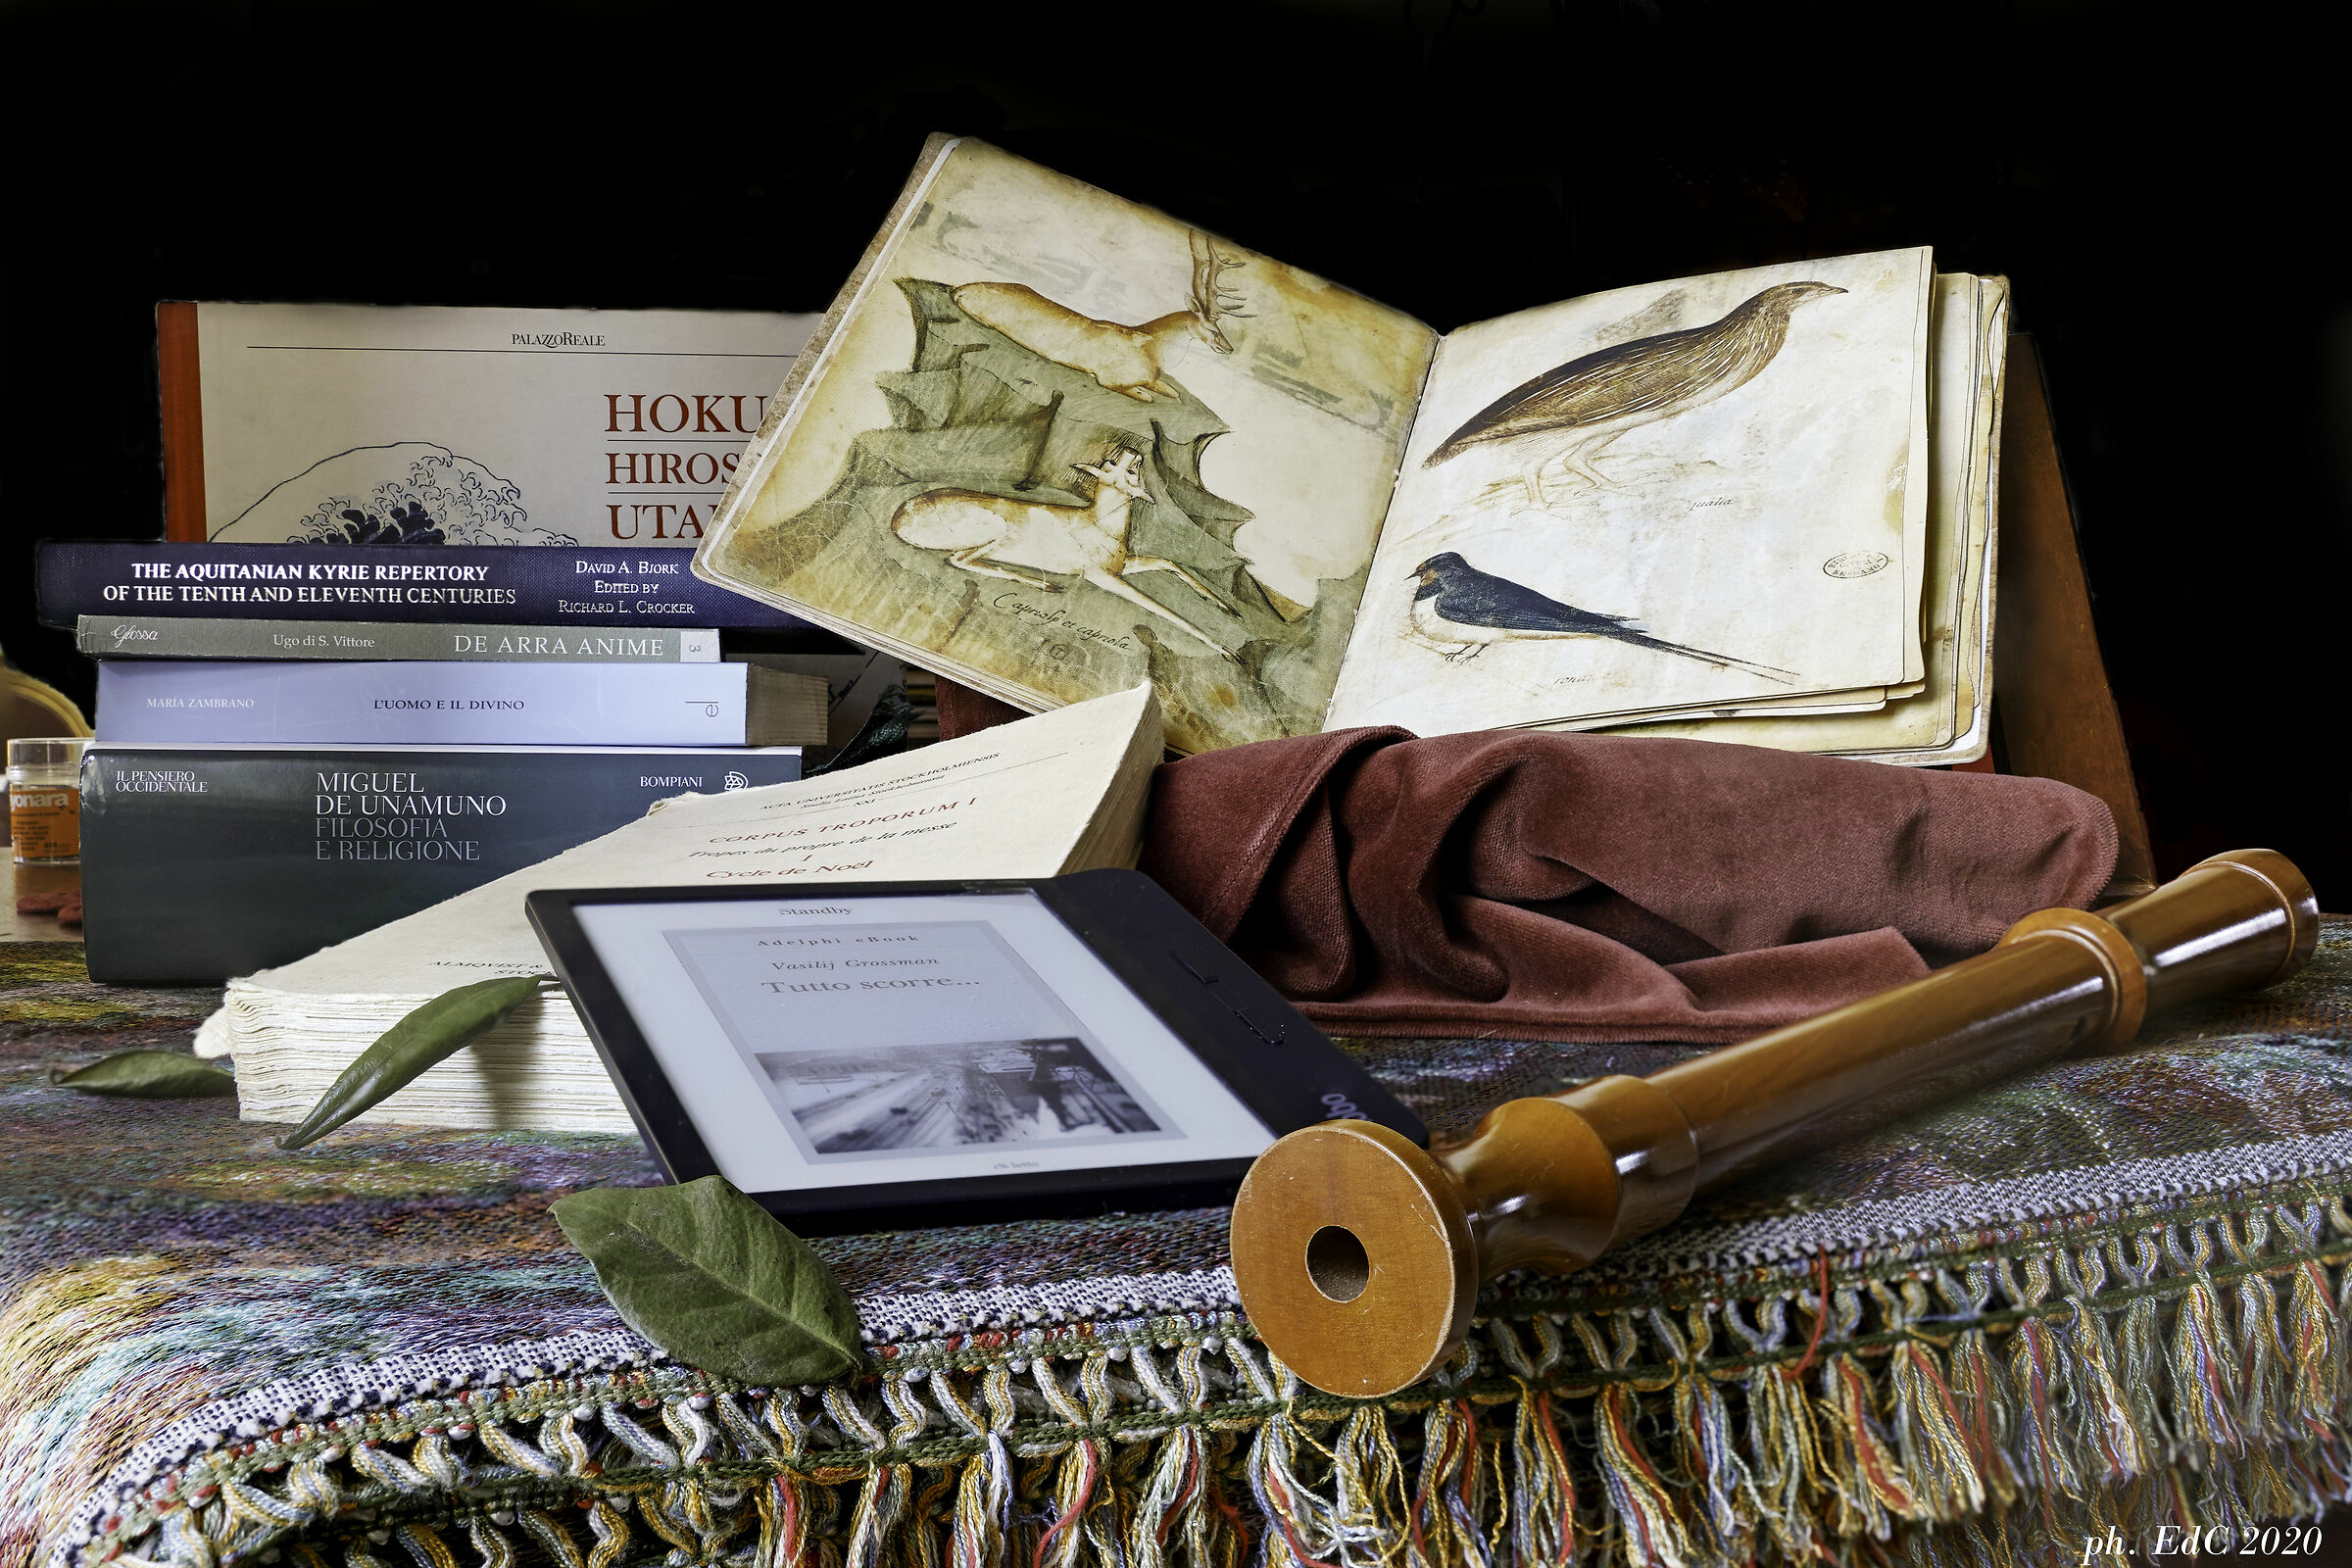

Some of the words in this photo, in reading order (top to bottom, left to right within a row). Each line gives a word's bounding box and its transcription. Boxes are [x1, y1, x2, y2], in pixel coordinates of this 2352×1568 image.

[606, 504, 717, 540] UTA
[131, 563, 172, 579] THE
[174, 564, 302, 581] AQUITANIAN
[309, 564, 369, 580] KYRIE
[375, 564, 489, 581] REPERTORY
[575, 560, 614, 574] DAVID
[617, 560, 633, 574] A.
[594, 579, 638, 594] EDITED
[642, 583, 660, 594] BY
[103, 585, 130, 602] OF
[133, 585, 173, 602] THE
[179, 586, 246, 602] TENTH
[249, 586, 293, 603] AND
[297, 587, 402, 604] ELEVENTH
[407, 588, 516, 605] CENTURIES
[558, 599, 614, 613] RICHARD
[617, 600, 632, 613] L.
[636, 600, 695, 614] CROCKER
[111, 624, 159, 648] Glossa
[273, 634, 300, 649] Ugo
[303, 634, 316, 647] di
[318, 635, 329, 647] S.
[334, 635, 375, 648] Vittore
[454, 635, 487, 653] DE
[497, 636, 568, 655] ARRA
[577, 637, 663, 656] ANIME
[147, 696, 184, 709] MARÍA
[188, 698, 255, 709] ZAMBRANO
[373, 699, 432, 710] L'UOMO
[436, 700, 446, 710] E
[450, 700, 465, 710] IL
[468, 700, 525, 710] DIVINO
[117, 770, 129, 782] IL
[131, 770, 195, 782] PENSIERO
[317, 772, 425, 794] MIGUEL
[640, 775, 704, 788] BOMPIANI
[116, 781, 208, 793] OCCIDENTALE
[316, 795, 352, 815] DE
[361, 795, 507, 815] UNAMUNO
[316, 817, 448, 839] FILOSOFIA
[710, 827, 808, 844] CORPUS
[818, 801, 959, 833] TROPORUM
[967, 797, 978, 806] I
[781, 840, 845, 854] propre
[849, 835, 873, 845] de
[876, 832, 898, 841] la
[901, 821, 957, 837] messe
[316, 841, 331, 860] E
[339, 841, 480, 861] RELIGIONE
[707, 869, 772, 879] Cycle
[777, 867, 808, 876] de
[779, 906, 854, 916] Standby
[758, 937, 843, 947] Adelphi
[771, 960, 835, 971] Vasilij
[845, 957, 940, 968] Grossman
[760, 981, 851, 994] Tutto
[859, 976, 981, 990] scorre...
